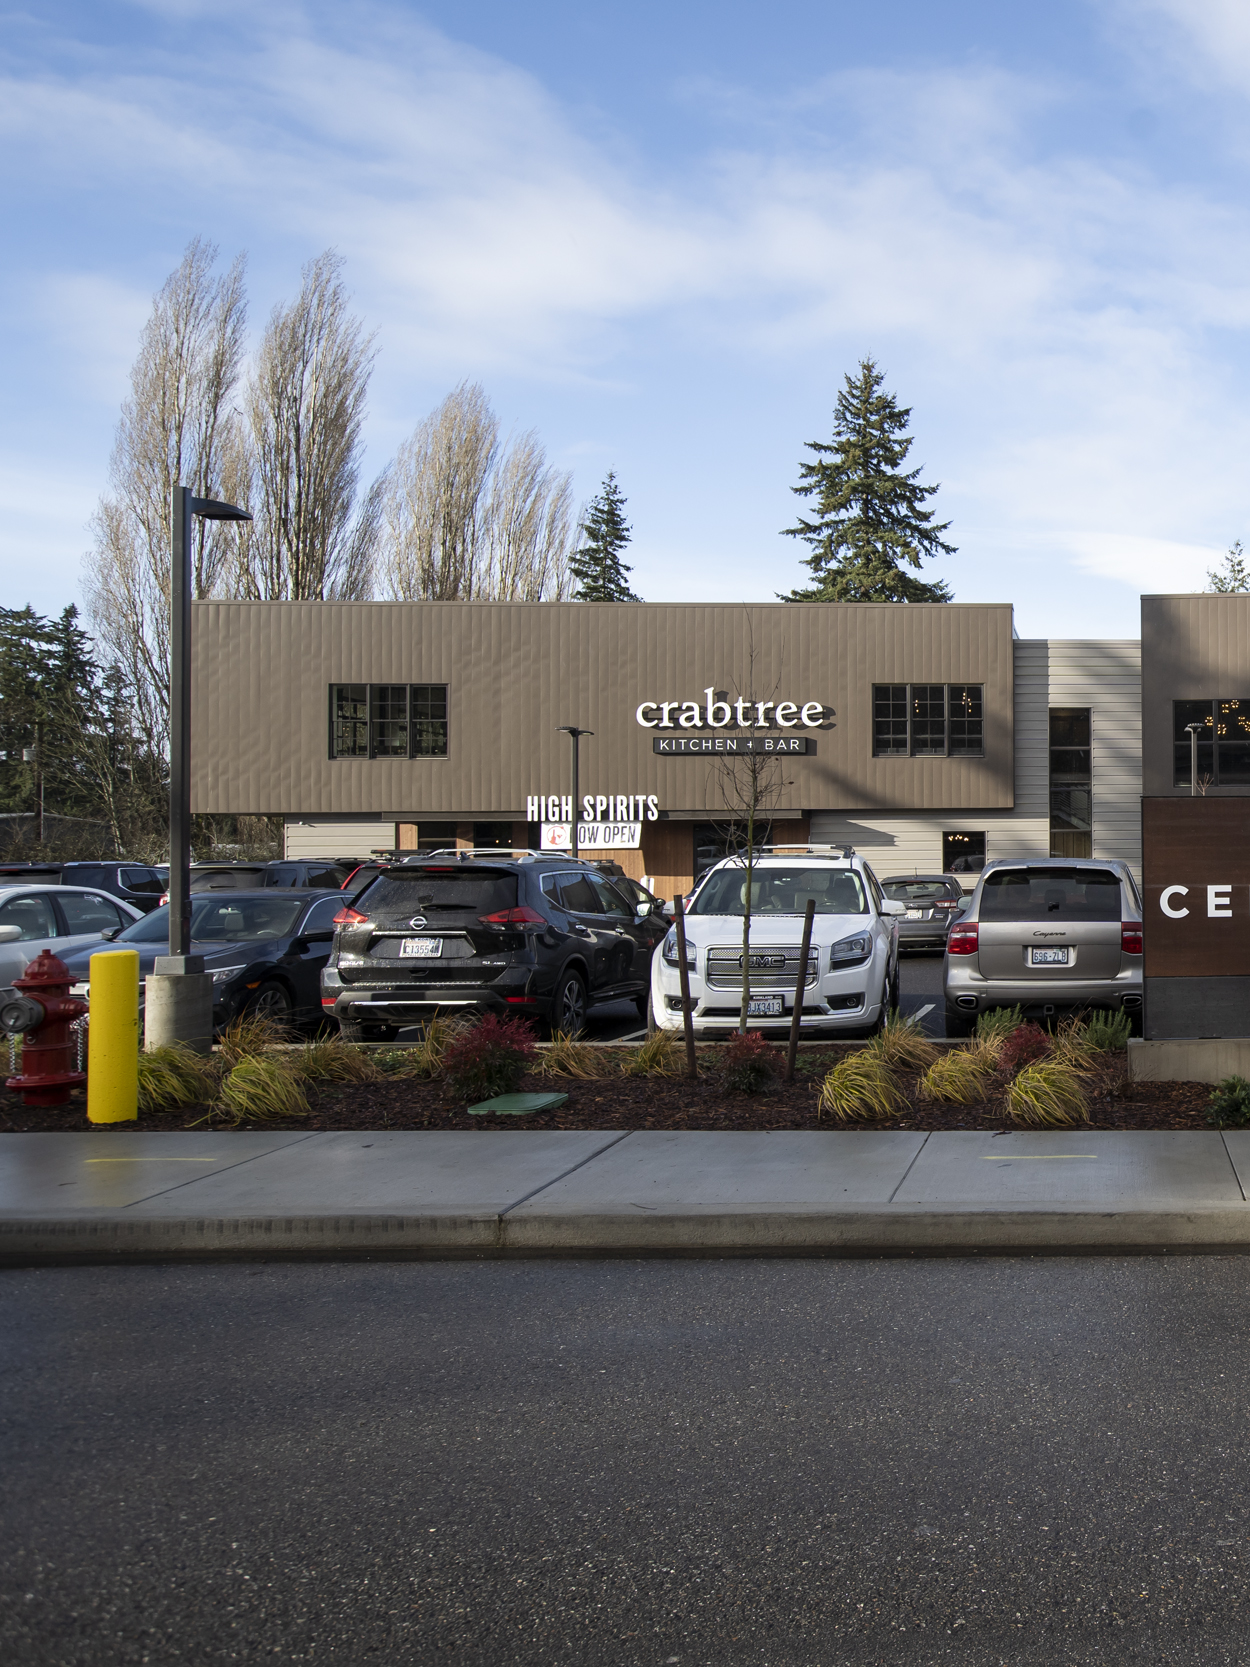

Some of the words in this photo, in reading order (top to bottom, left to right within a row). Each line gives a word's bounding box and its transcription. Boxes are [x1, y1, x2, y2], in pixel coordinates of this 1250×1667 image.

[635, 686, 824, 727] crabtree
[659, 739, 737, 750] KITCHEN
[765, 739, 800, 750] BAR
[527, 795, 573, 822] HIGH
[583, 794, 659, 821] SPIRITS
[569, 825, 599, 844] OW
[603, 825, 636, 844] OPEN
[1032, 930, 1067, 939] Cayenne
[740, 956, 785, 967] GMC
